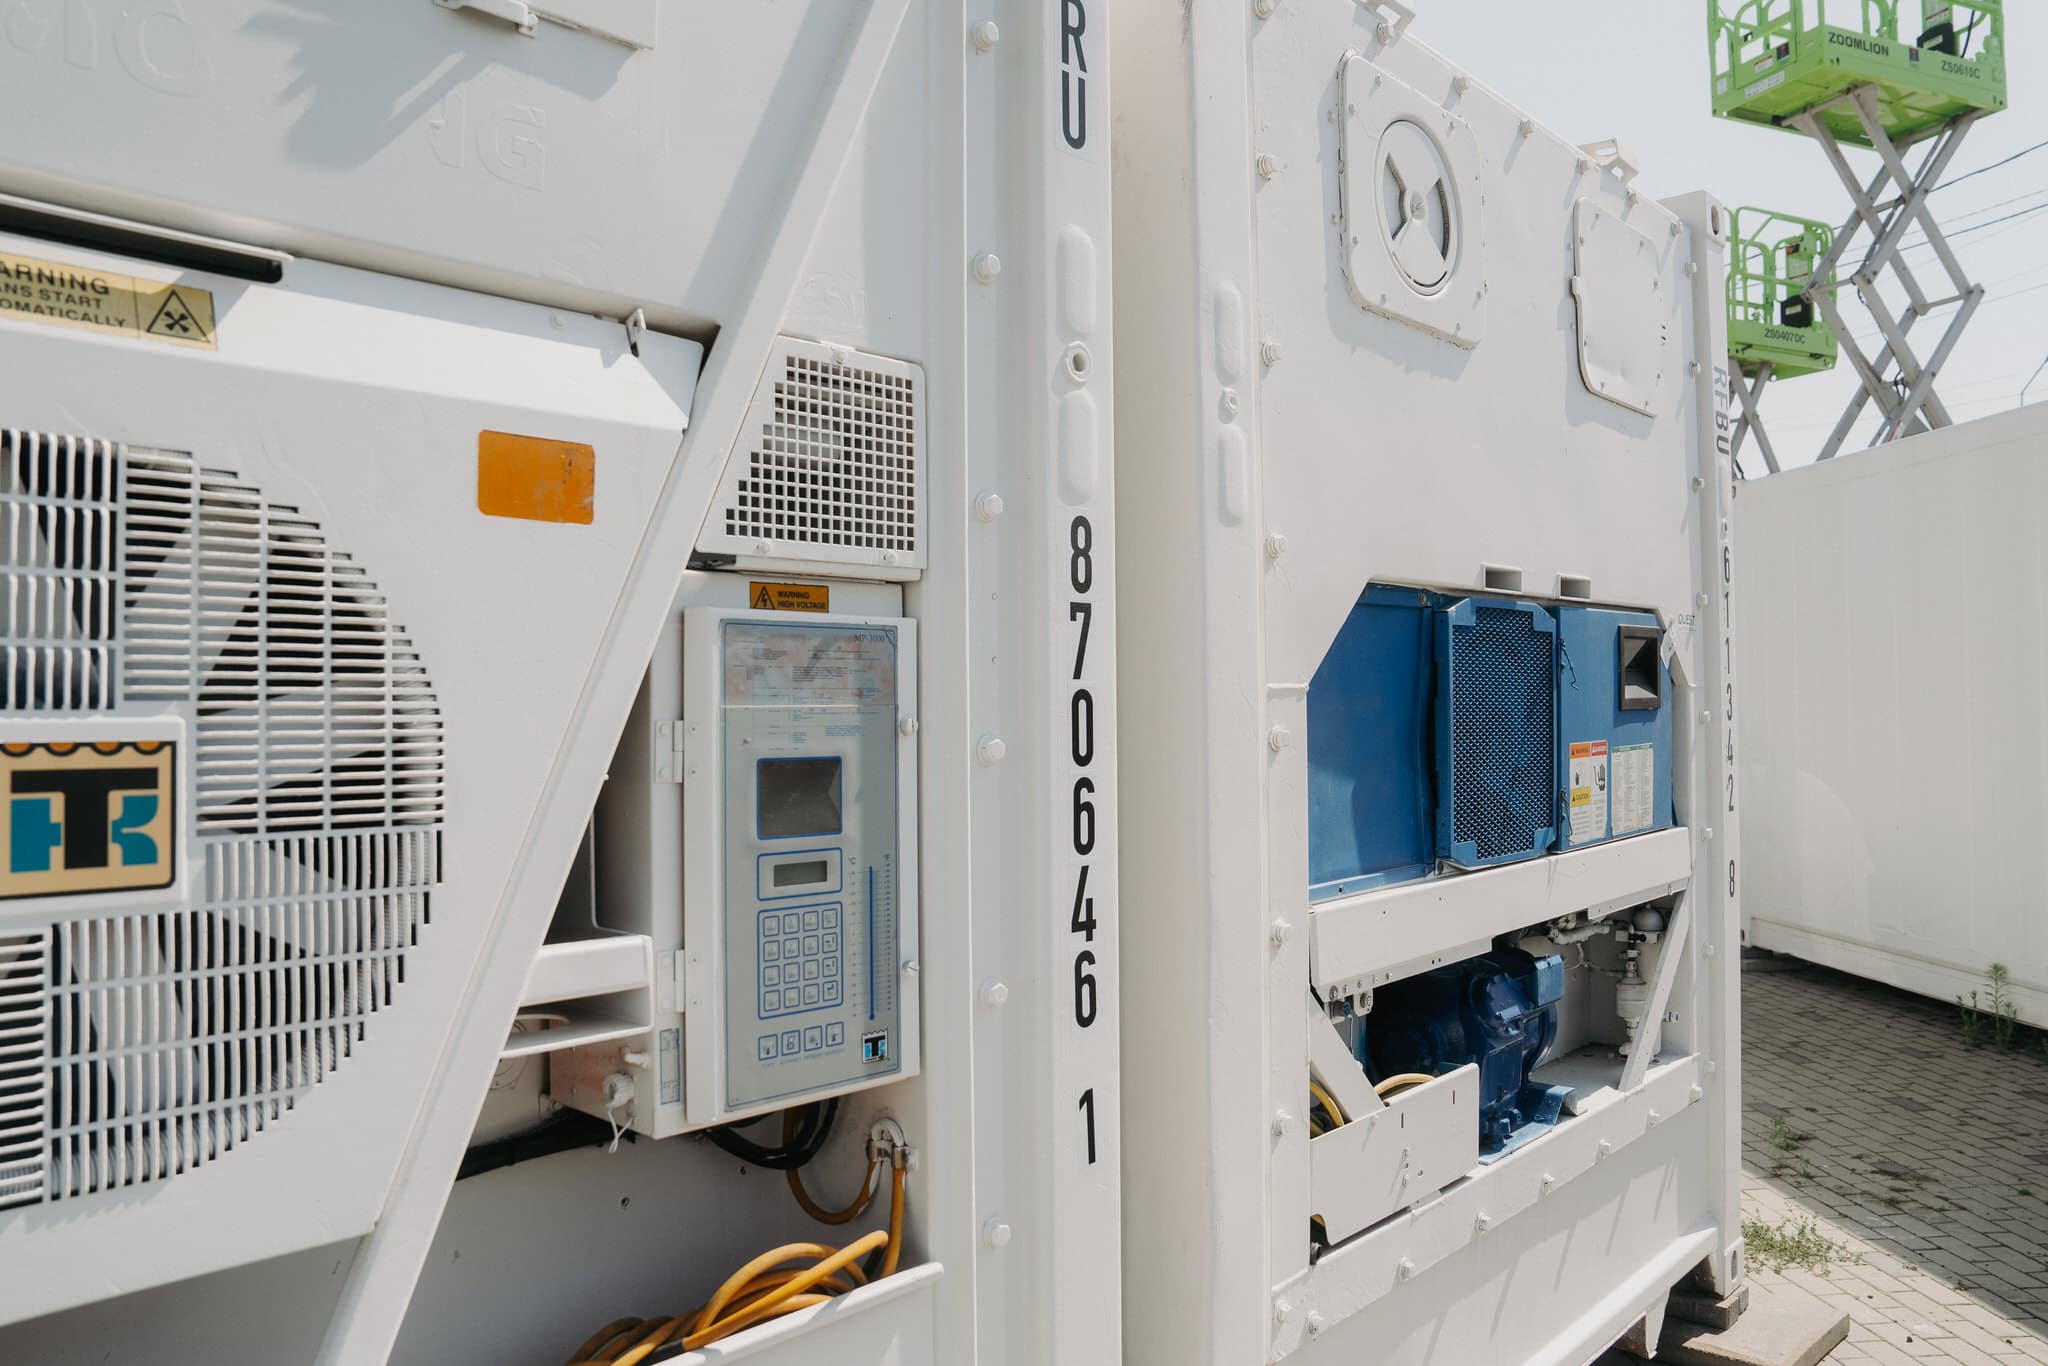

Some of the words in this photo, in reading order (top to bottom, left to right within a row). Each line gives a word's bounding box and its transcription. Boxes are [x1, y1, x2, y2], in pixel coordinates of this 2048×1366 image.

[1828, 31, 1889, 57] ZOOMLION
[1061, 0, 1088, 150] RU
[0, 282, 33, 299] NS
[39, 288, 104, 309] START
[777, 591, 810, 599] WARNING
[796, 602, 827, 610] VOLTAGE
[1070, 515, 1097, 1028] 870646
[1729, 859, 1735, 898] 8
[1078, 1087, 1096, 1165] 1
